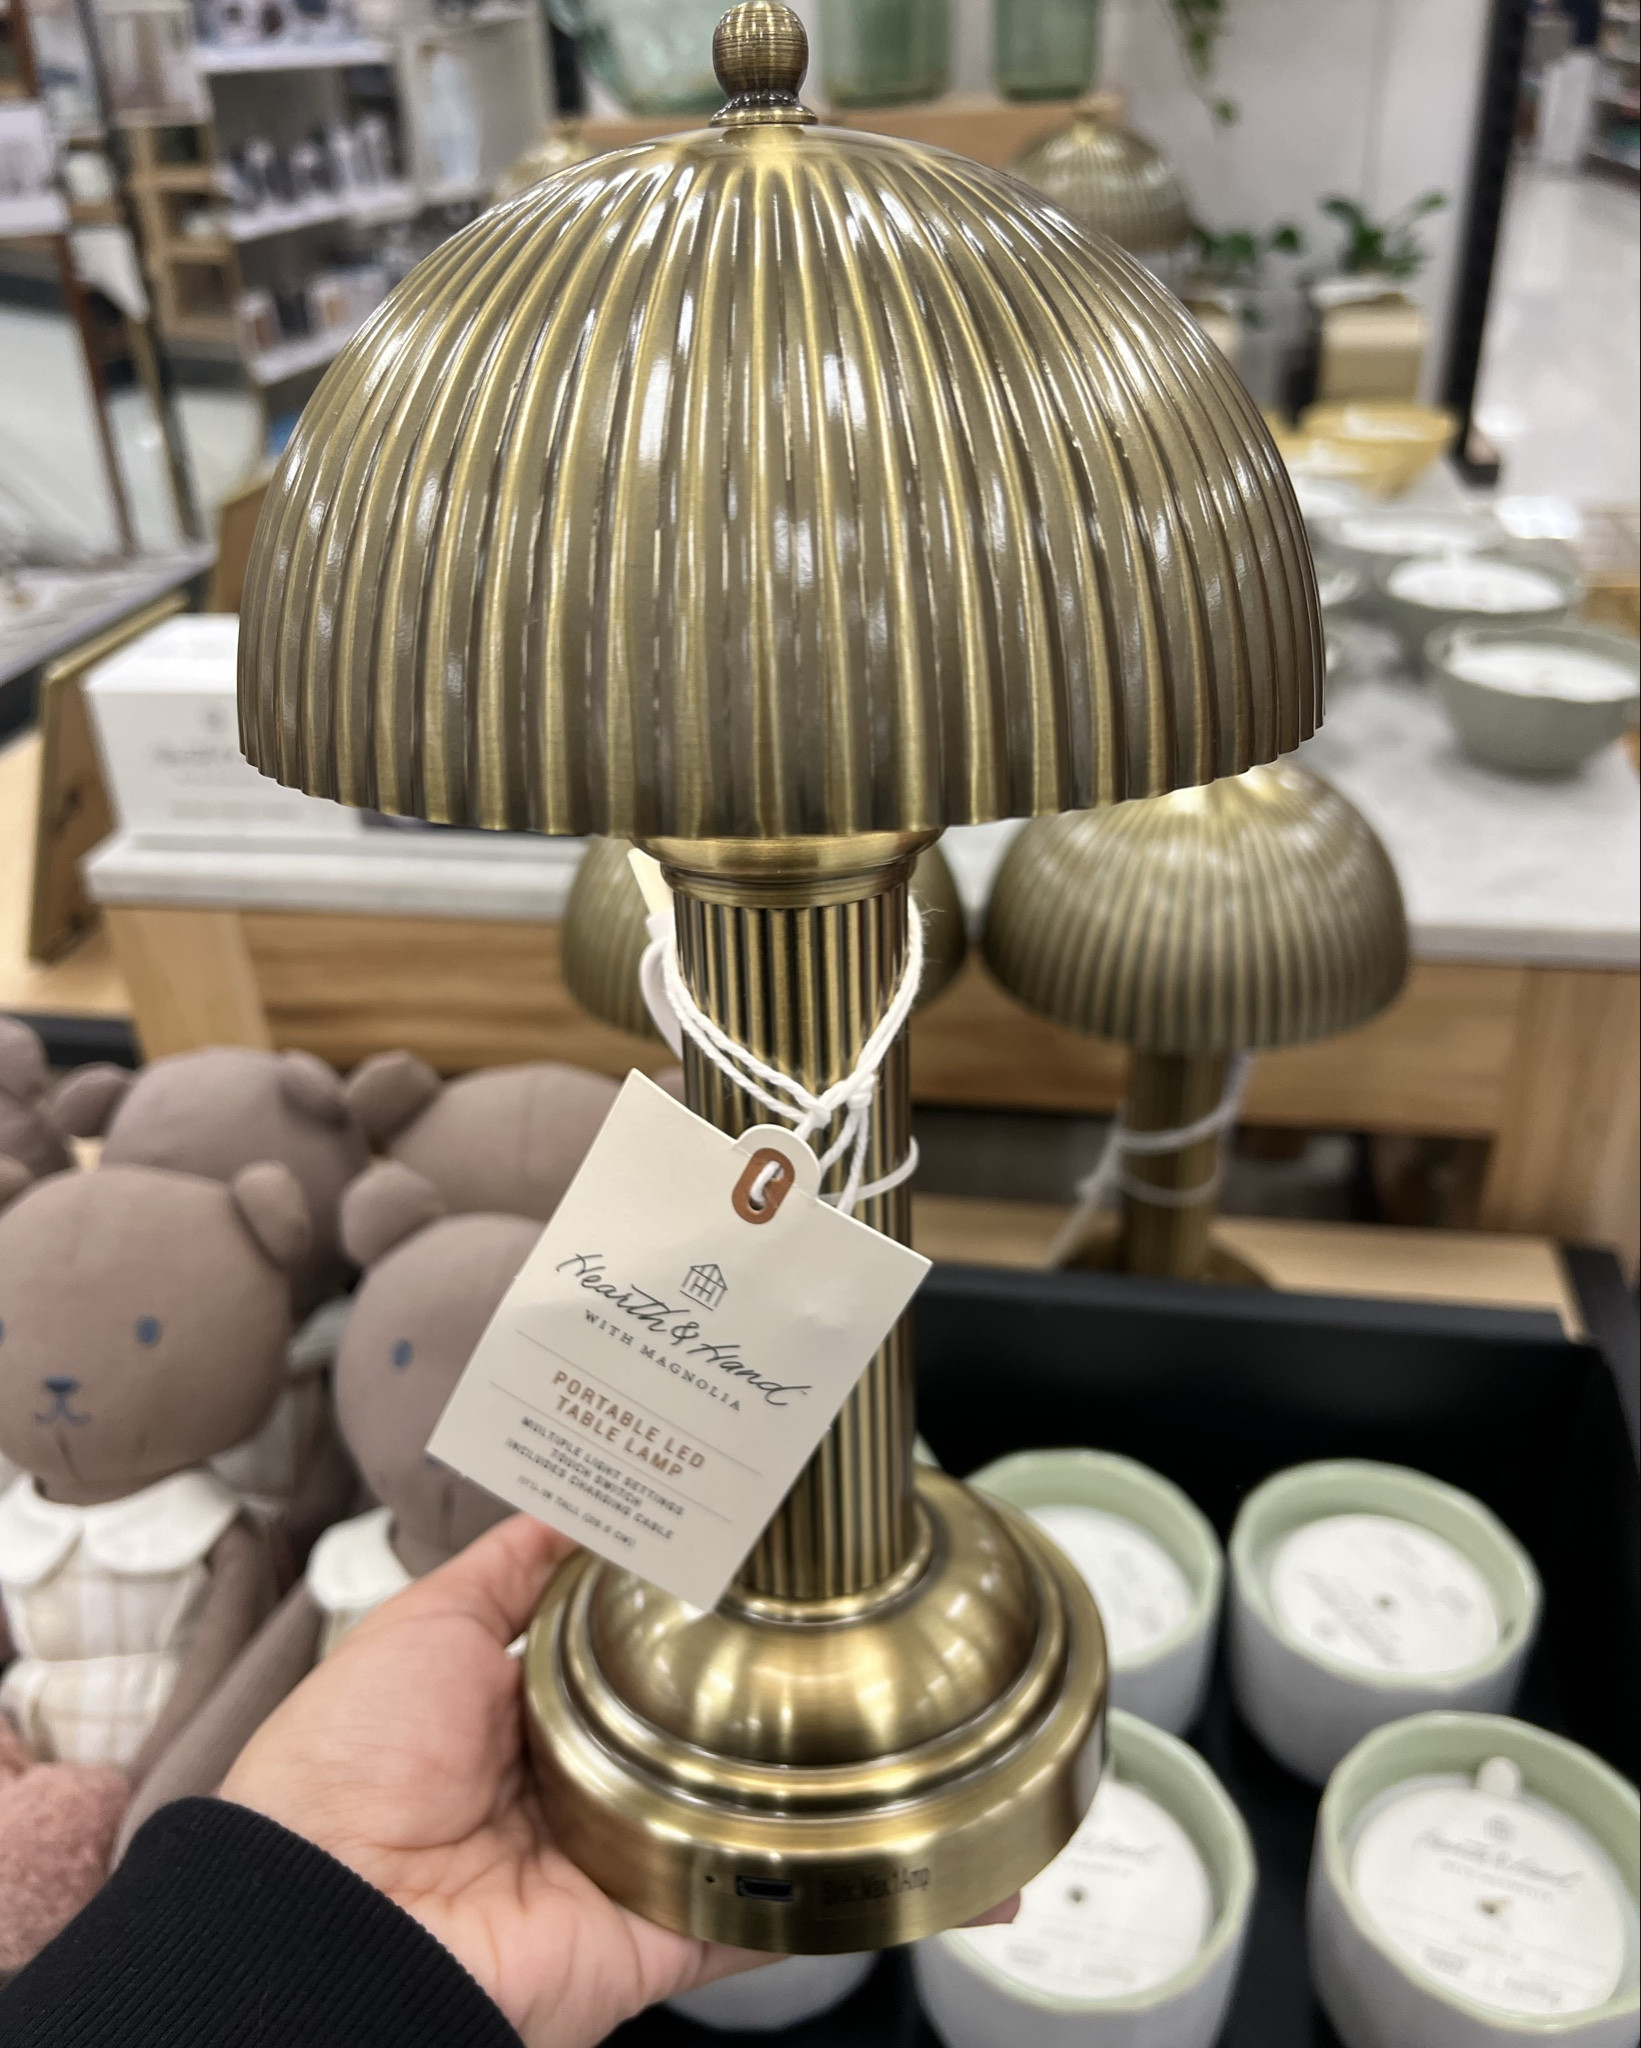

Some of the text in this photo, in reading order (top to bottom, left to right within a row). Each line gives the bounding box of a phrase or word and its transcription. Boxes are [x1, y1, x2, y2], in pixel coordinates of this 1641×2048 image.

[556, 1254, 812, 1406] Hearth & Hand
[584, 1310, 741, 1412] WITH MAGNOLIA
[521, 1416, 685, 1516] MULTIPLE LIGHT SETTINGS
[552, 1370, 706, 1469] PORTABLE LED
[555, 1395, 685, 1477] TABLE LAMP
[505, 1438, 675, 1540] INCLUDES CHARGING CABLE
[551, 1448, 643, 1507] TOUCH SWITCH
